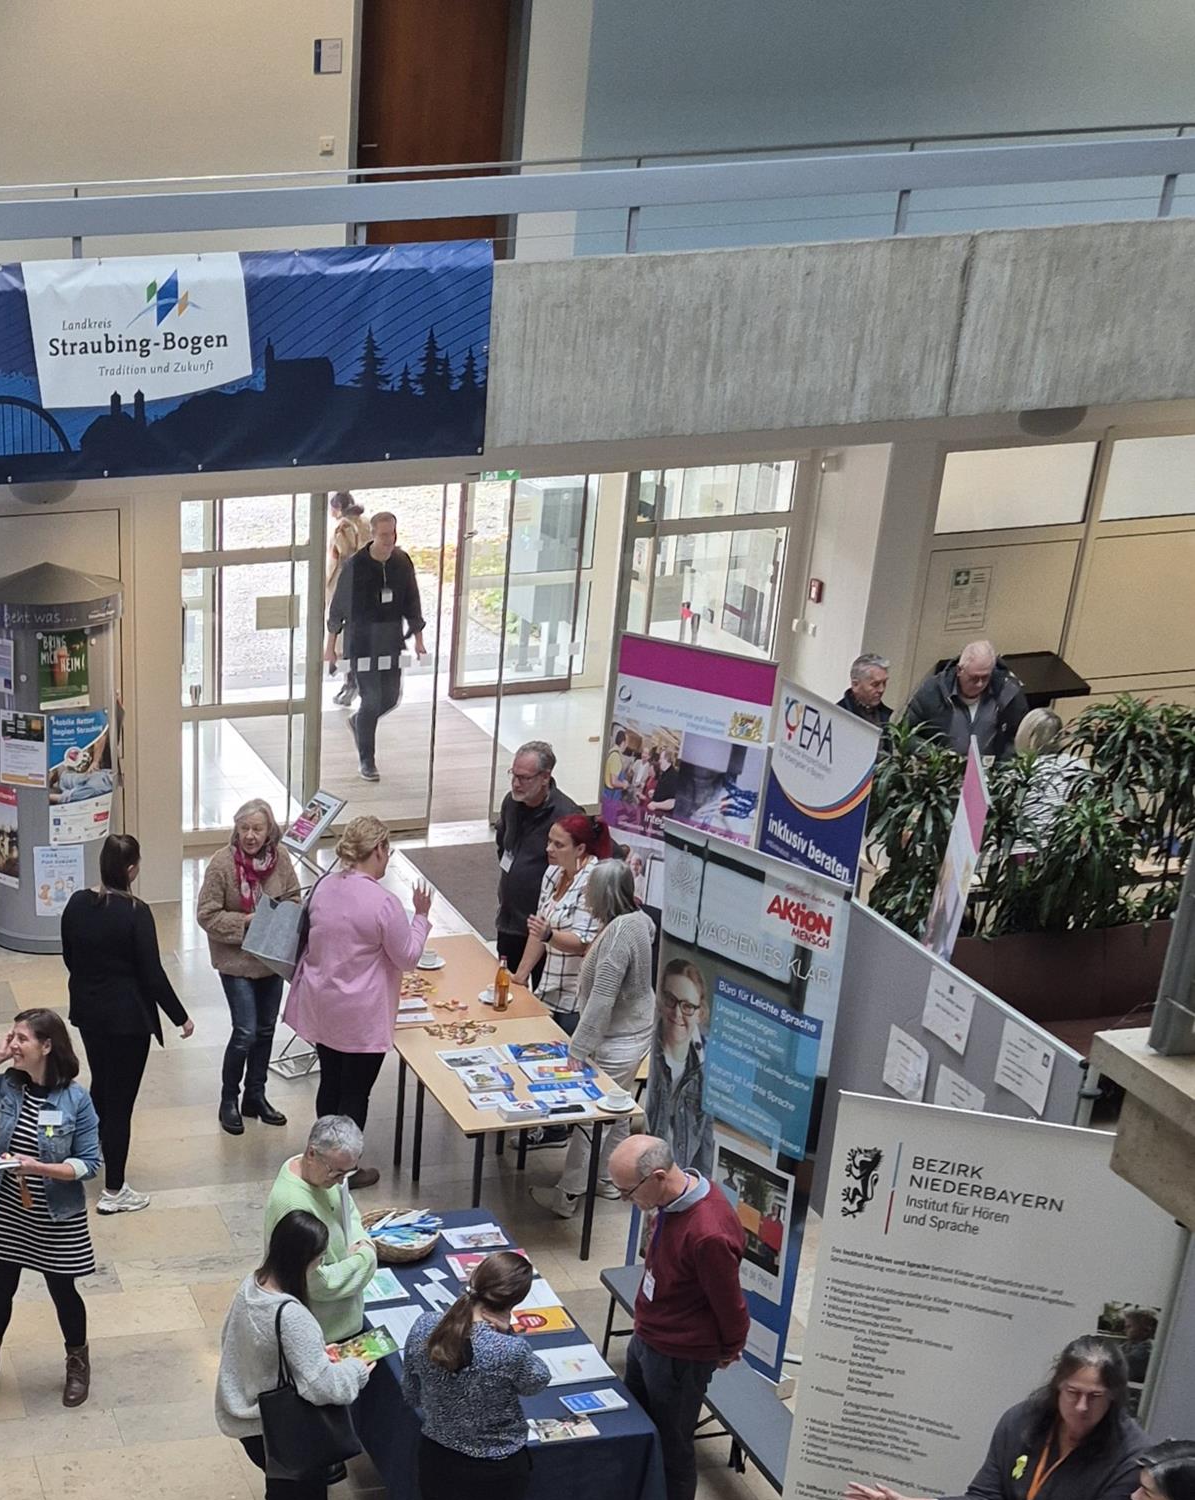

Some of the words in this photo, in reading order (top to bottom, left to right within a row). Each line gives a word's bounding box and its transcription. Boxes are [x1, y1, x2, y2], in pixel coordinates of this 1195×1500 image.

[61, 318, 112, 331] Landkreis
[48, 332, 228, 358] Straubing-Bogen
[98, 364, 147, 377] Tradition
[150, 363, 170, 375] und
[173, 360, 214, 374] Zukunft
[34, 612, 61, 624] was
[42, 634, 67, 650] BRING
[768, 813, 807, 854] inklusiv
[808, 840, 850, 880] beraten
[791, 928, 830, 949] MENSCH
[693, 917, 760, 957] MACHEN
[762, 943, 784, 970] ES
[787, 956, 832, 986] KLAR
[718, 979, 736, 997] Büro
[737, 989, 749, 1002] für
[749, 994, 779, 1017] Leichte
[779, 1008, 817, 1035] Sprache
[766, 1088, 796, 1113] Sprache
[912, 1156, 984, 1180] BEZIRK
[909, 1174, 1064, 1213] NIEDERBAYERN
[906, 1194, 948, 1213] Institut
[951, 1201, 969, 1216] für
[972, 1206, 1009, 1224] Hören
[903, 1213, 926, 1226] und
[929, 1215, 980, 1236] Sprache
